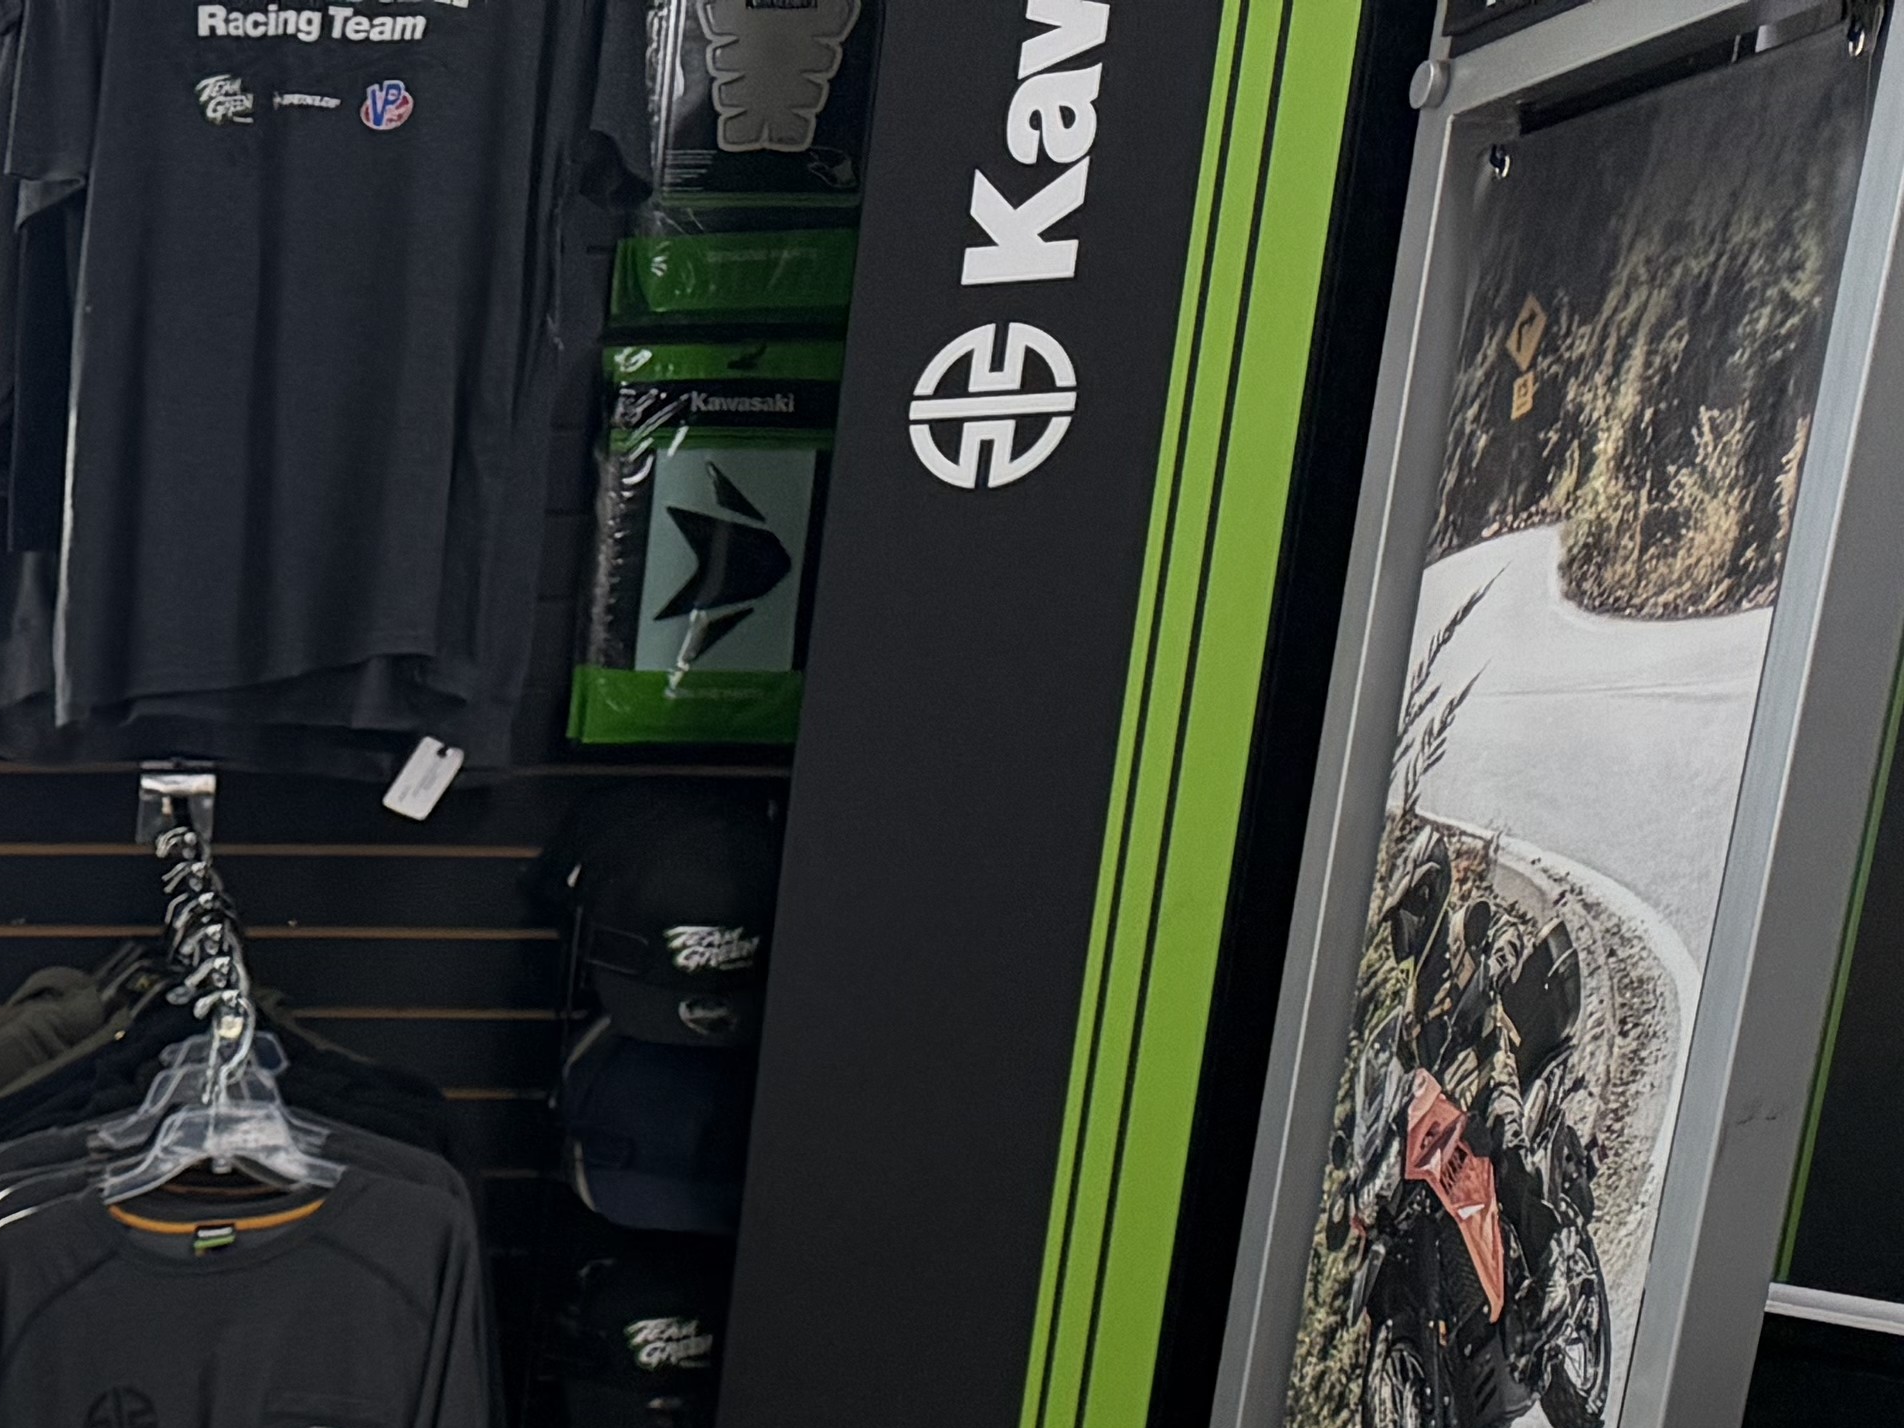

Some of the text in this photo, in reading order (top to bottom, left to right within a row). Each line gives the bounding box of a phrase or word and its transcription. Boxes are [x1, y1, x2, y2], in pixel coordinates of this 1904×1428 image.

[197, 4, 427, 42] Racing Team
[690, 389, 795, 413] Kawasaki
